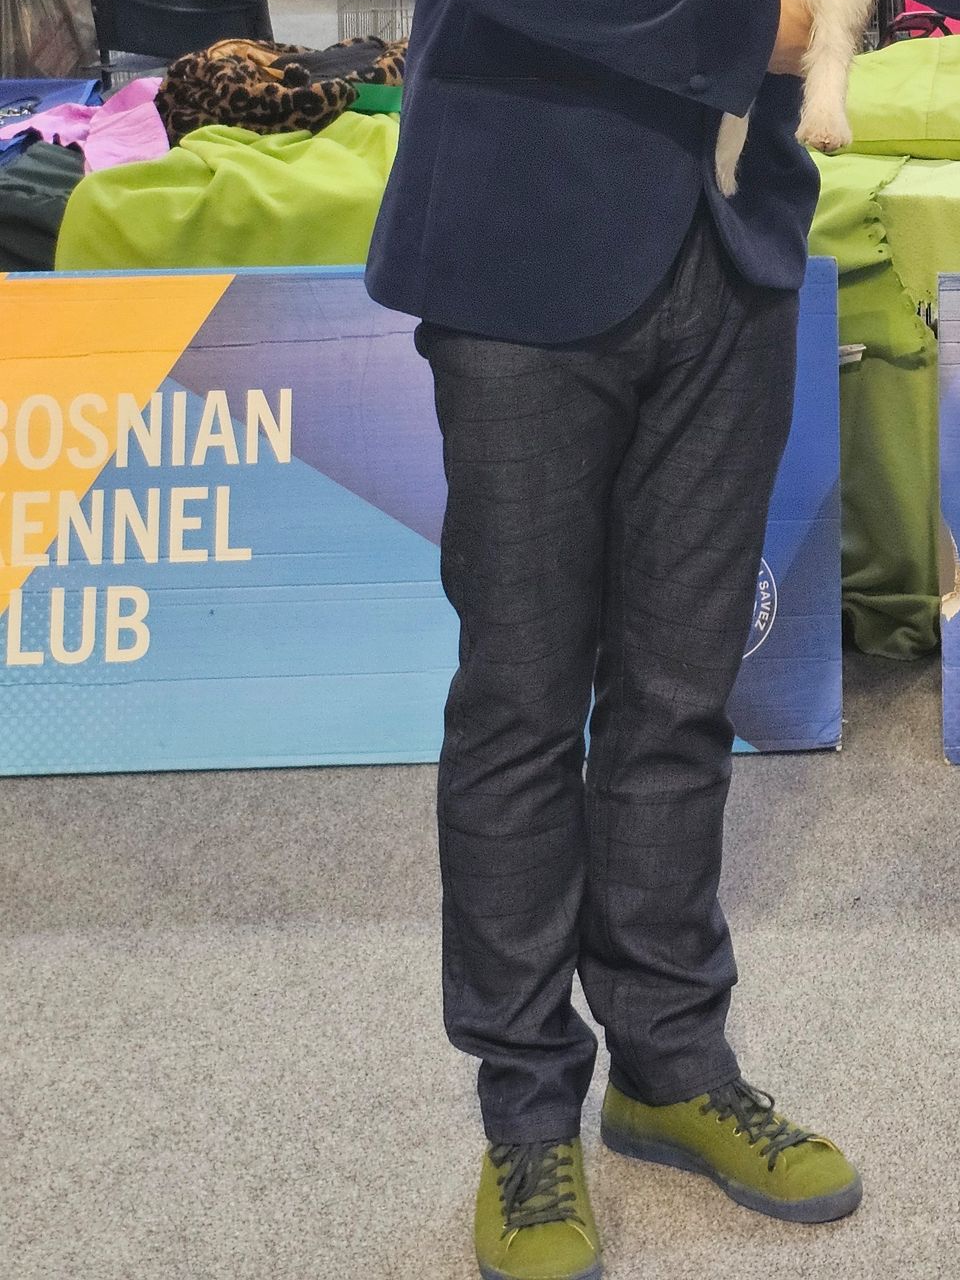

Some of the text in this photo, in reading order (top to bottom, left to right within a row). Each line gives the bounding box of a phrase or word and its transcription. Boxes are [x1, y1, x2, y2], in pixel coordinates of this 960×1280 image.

[0, 388, 292, 470] OSNIAN
[0, 486, 252, 568] ENNEL
[755, 580, 771, 631] SAVEZ
